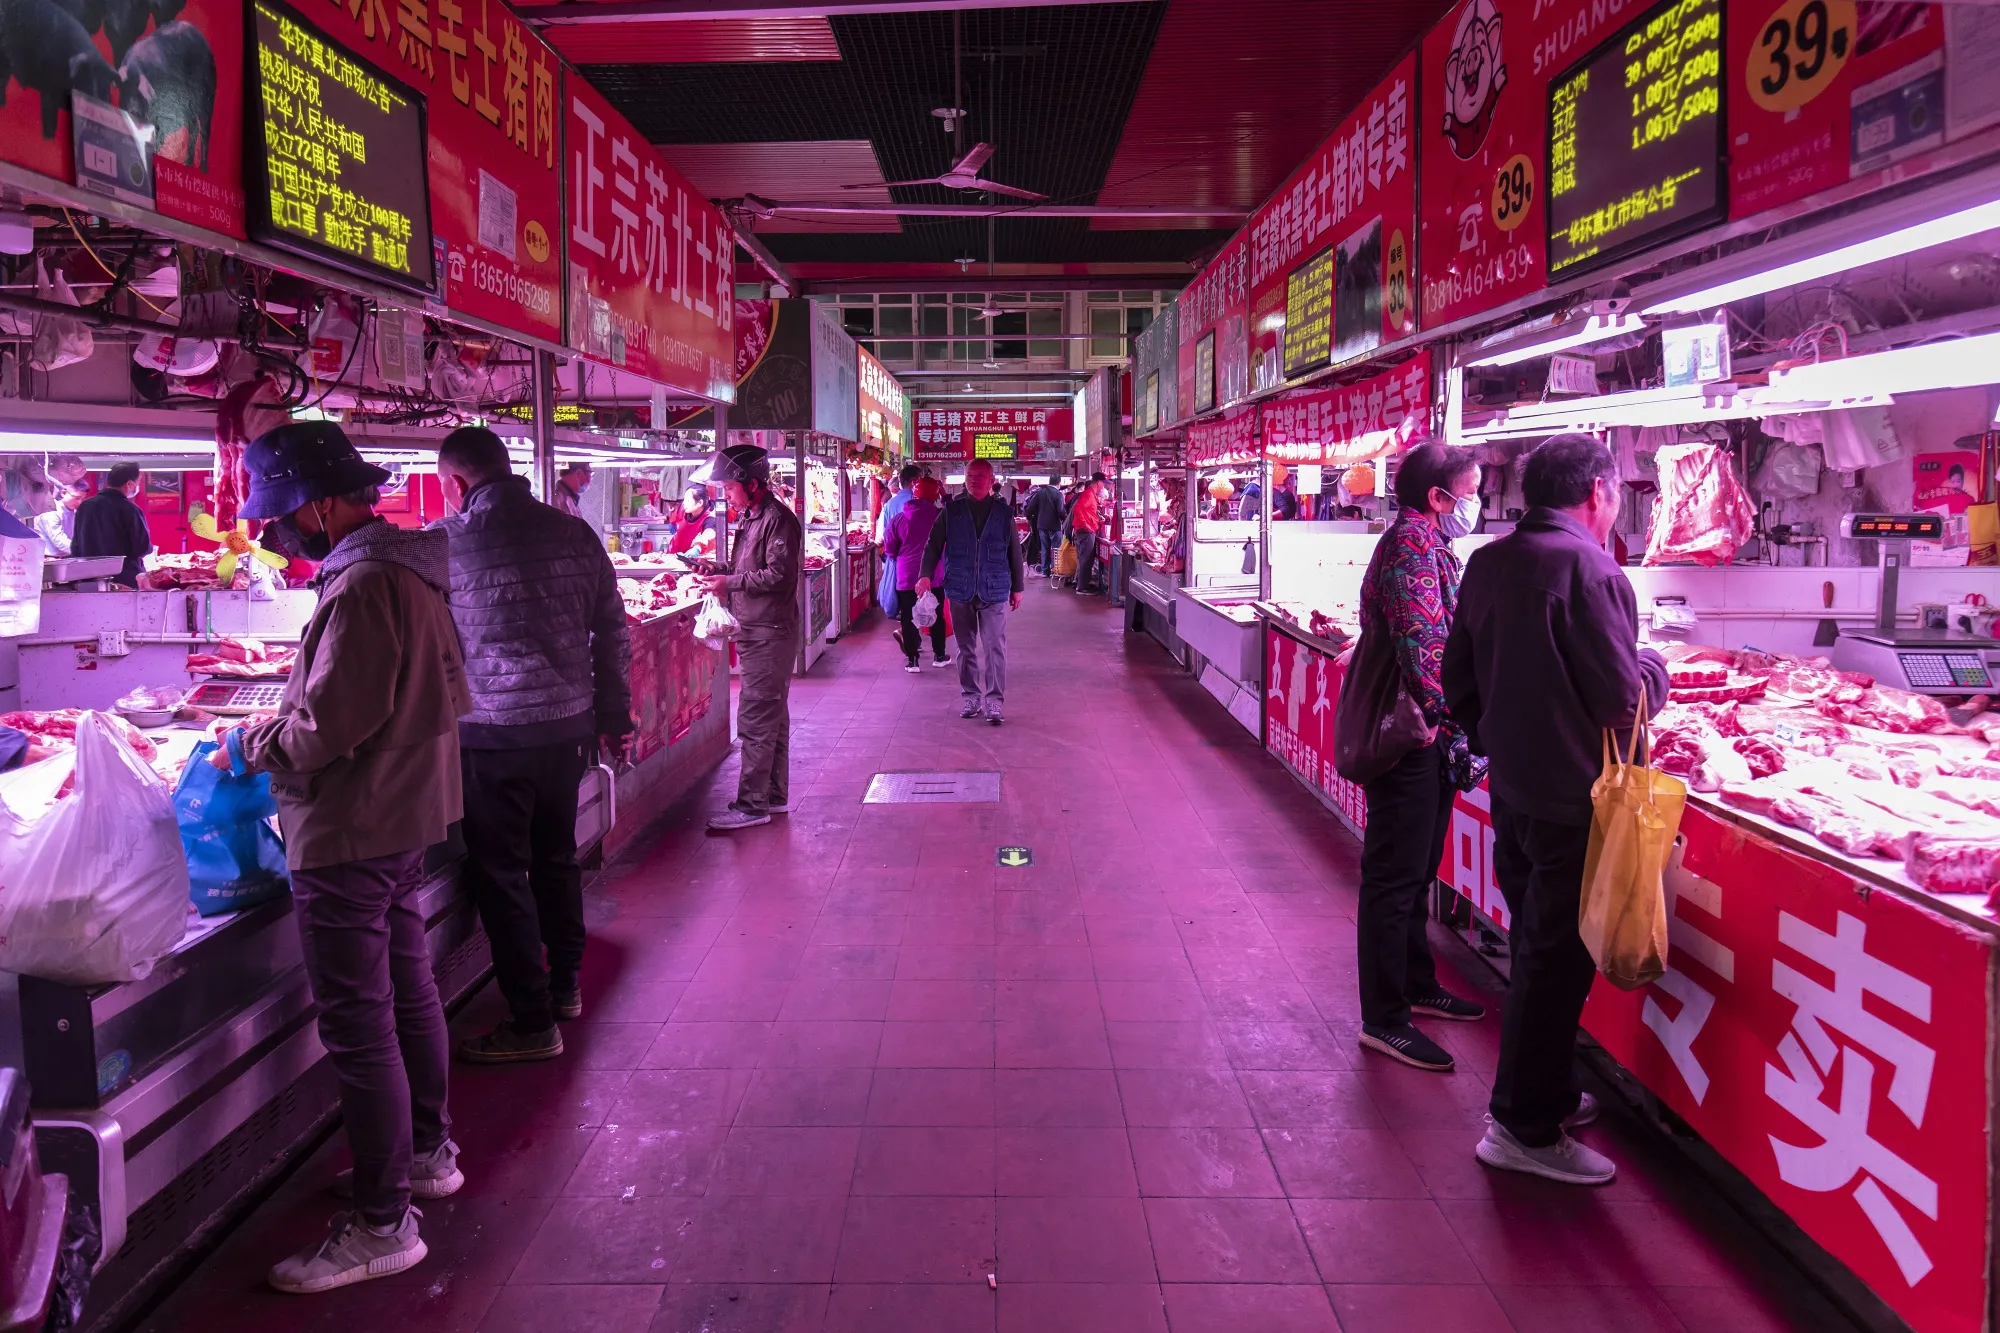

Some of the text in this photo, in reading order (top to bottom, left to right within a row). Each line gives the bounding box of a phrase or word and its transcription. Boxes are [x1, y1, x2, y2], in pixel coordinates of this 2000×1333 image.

[258, 42, 322, 107] 热烈庆祝
[1552, 12, 1720, 140] 五花 30.00元/500g
[1632, 49, 1719, 117] 1.00元/500g
[261, 81, 366, 164] 中华人民共和国
[264, 118, 341, 180] 成立72周年
[1552, 86, 1719, 198] 测试 1.00元/500g
[209, 206, 231, 229] 500g
[267, 154, 412, 243] 中国共产党成立100周年
[270, 189, 410, 273] 戴口罩 勤洗手 勤通风
[573, 95, 731, 332] 正宗苏北土猪
[471, 258, 550, 315] 13651965298
[1423, 244, 1529, 314] 13818464439
[918, 411, 1046, 426] 黑毛猪 双汇生鲜肉
[918, 429, 962, 443] 专卖店
